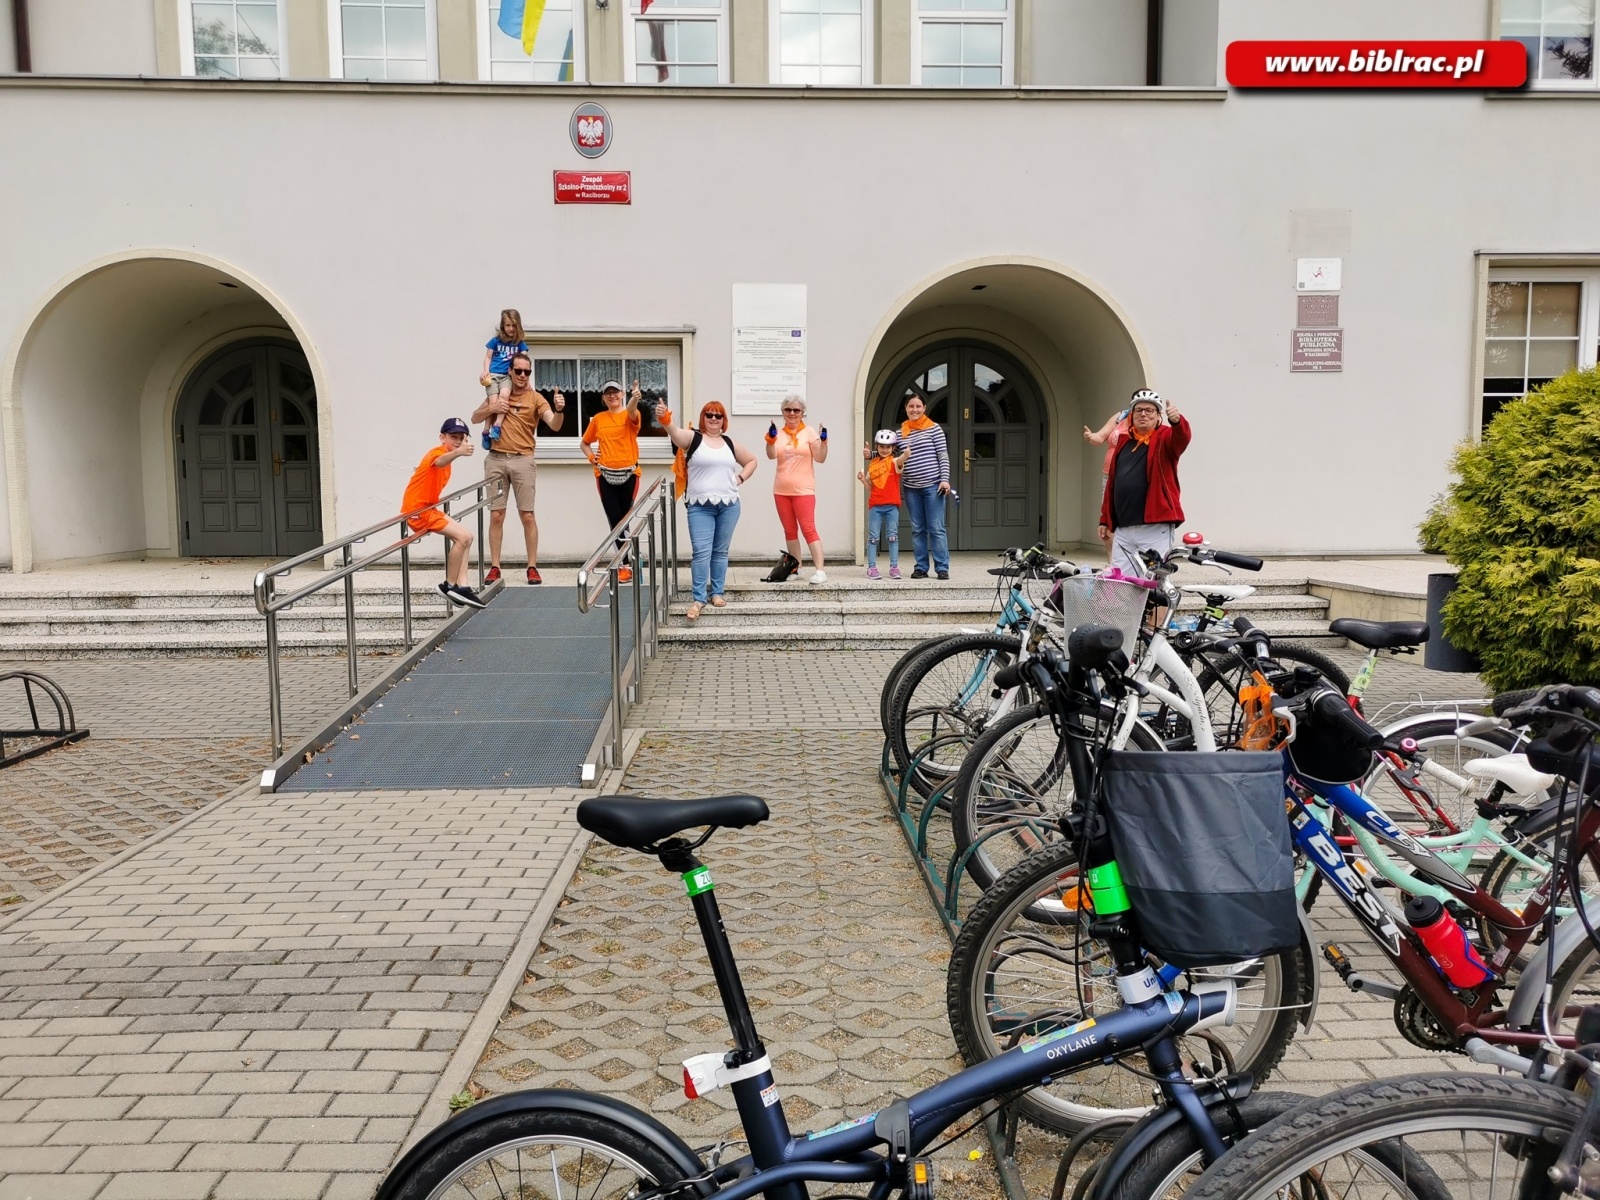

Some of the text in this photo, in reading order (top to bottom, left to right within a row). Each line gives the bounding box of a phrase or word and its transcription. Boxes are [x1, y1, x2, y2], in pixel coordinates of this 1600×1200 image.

[558, 183, 615, 192] Szkolno-Przedszkolny
[581, 176, 602, 184] Zespół
[1308, 831, 1406, 940] BEST
[1046, 1034, 1098, 1060] OXYLANE
